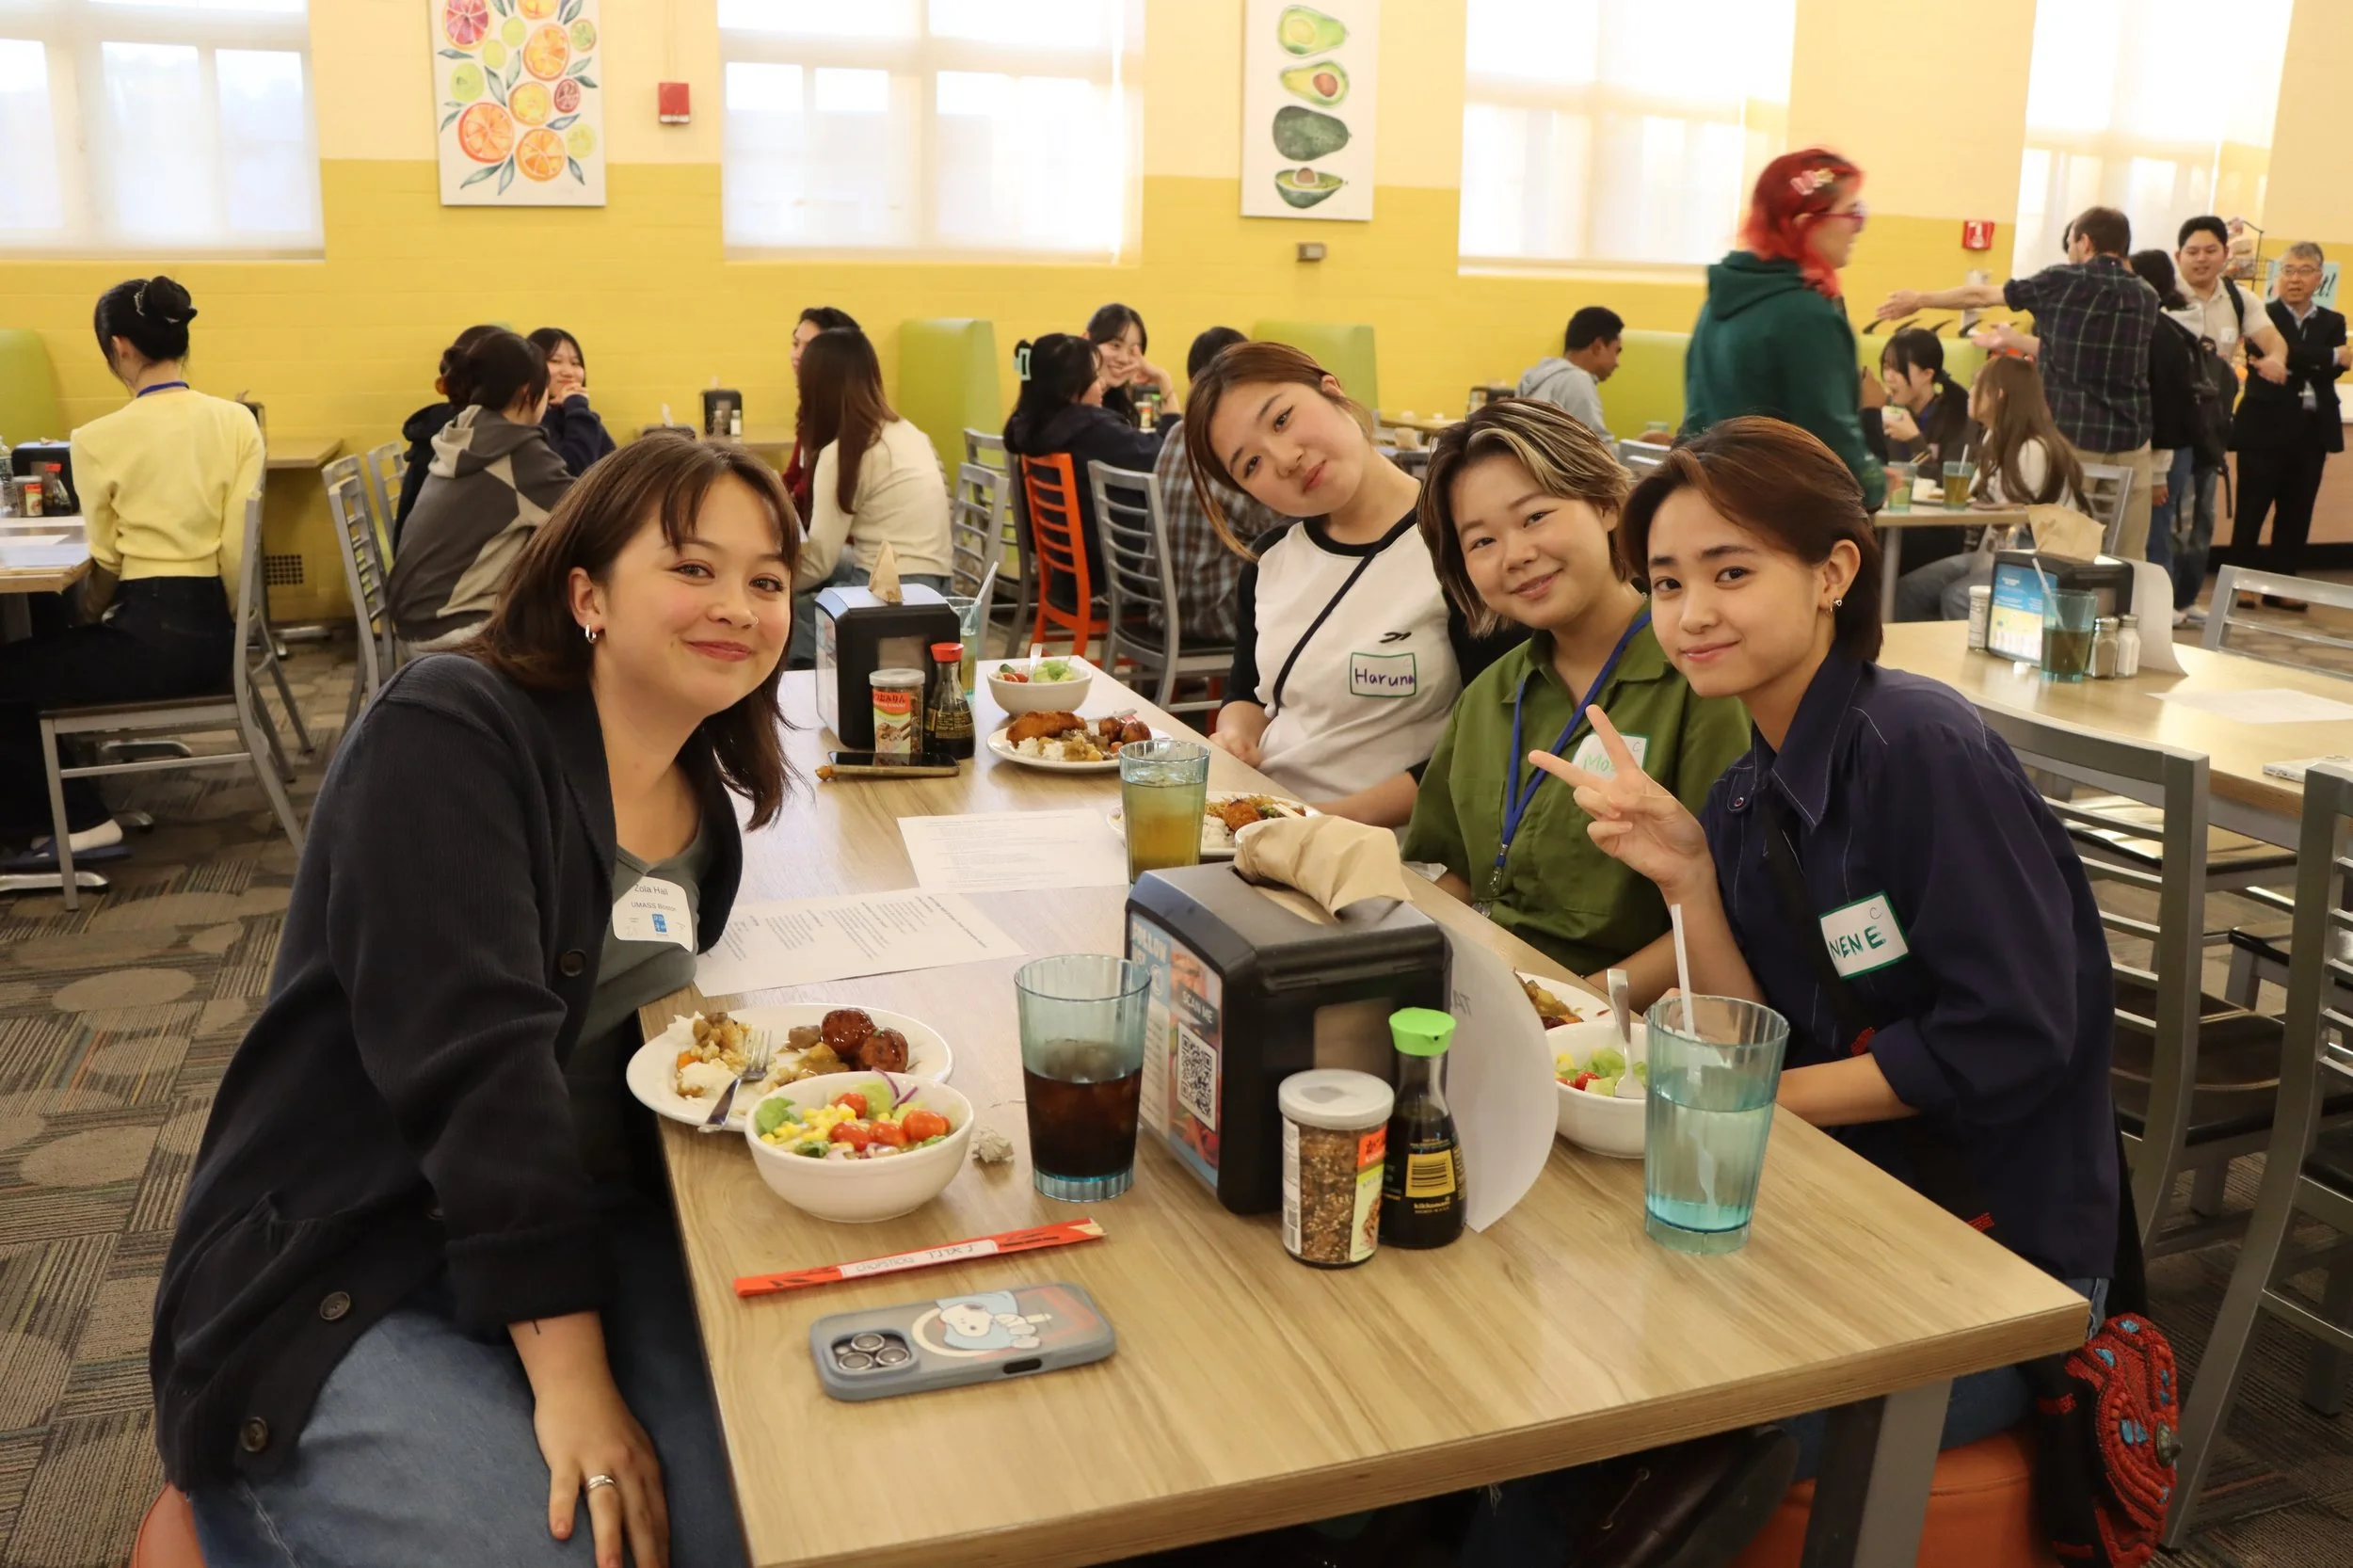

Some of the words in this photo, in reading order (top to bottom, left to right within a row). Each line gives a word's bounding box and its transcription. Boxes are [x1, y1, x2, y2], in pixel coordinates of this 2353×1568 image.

[634, 884, 652, 893] Zola
[631, 901, 656, 910] UMASS
[1829, 924, 1887, 960] NENE
[1182, 990, 1201, 1015] SCAN
[1202, 1005, 1213, 1025] ME
[1449, 989, 1472, 1017] AT
